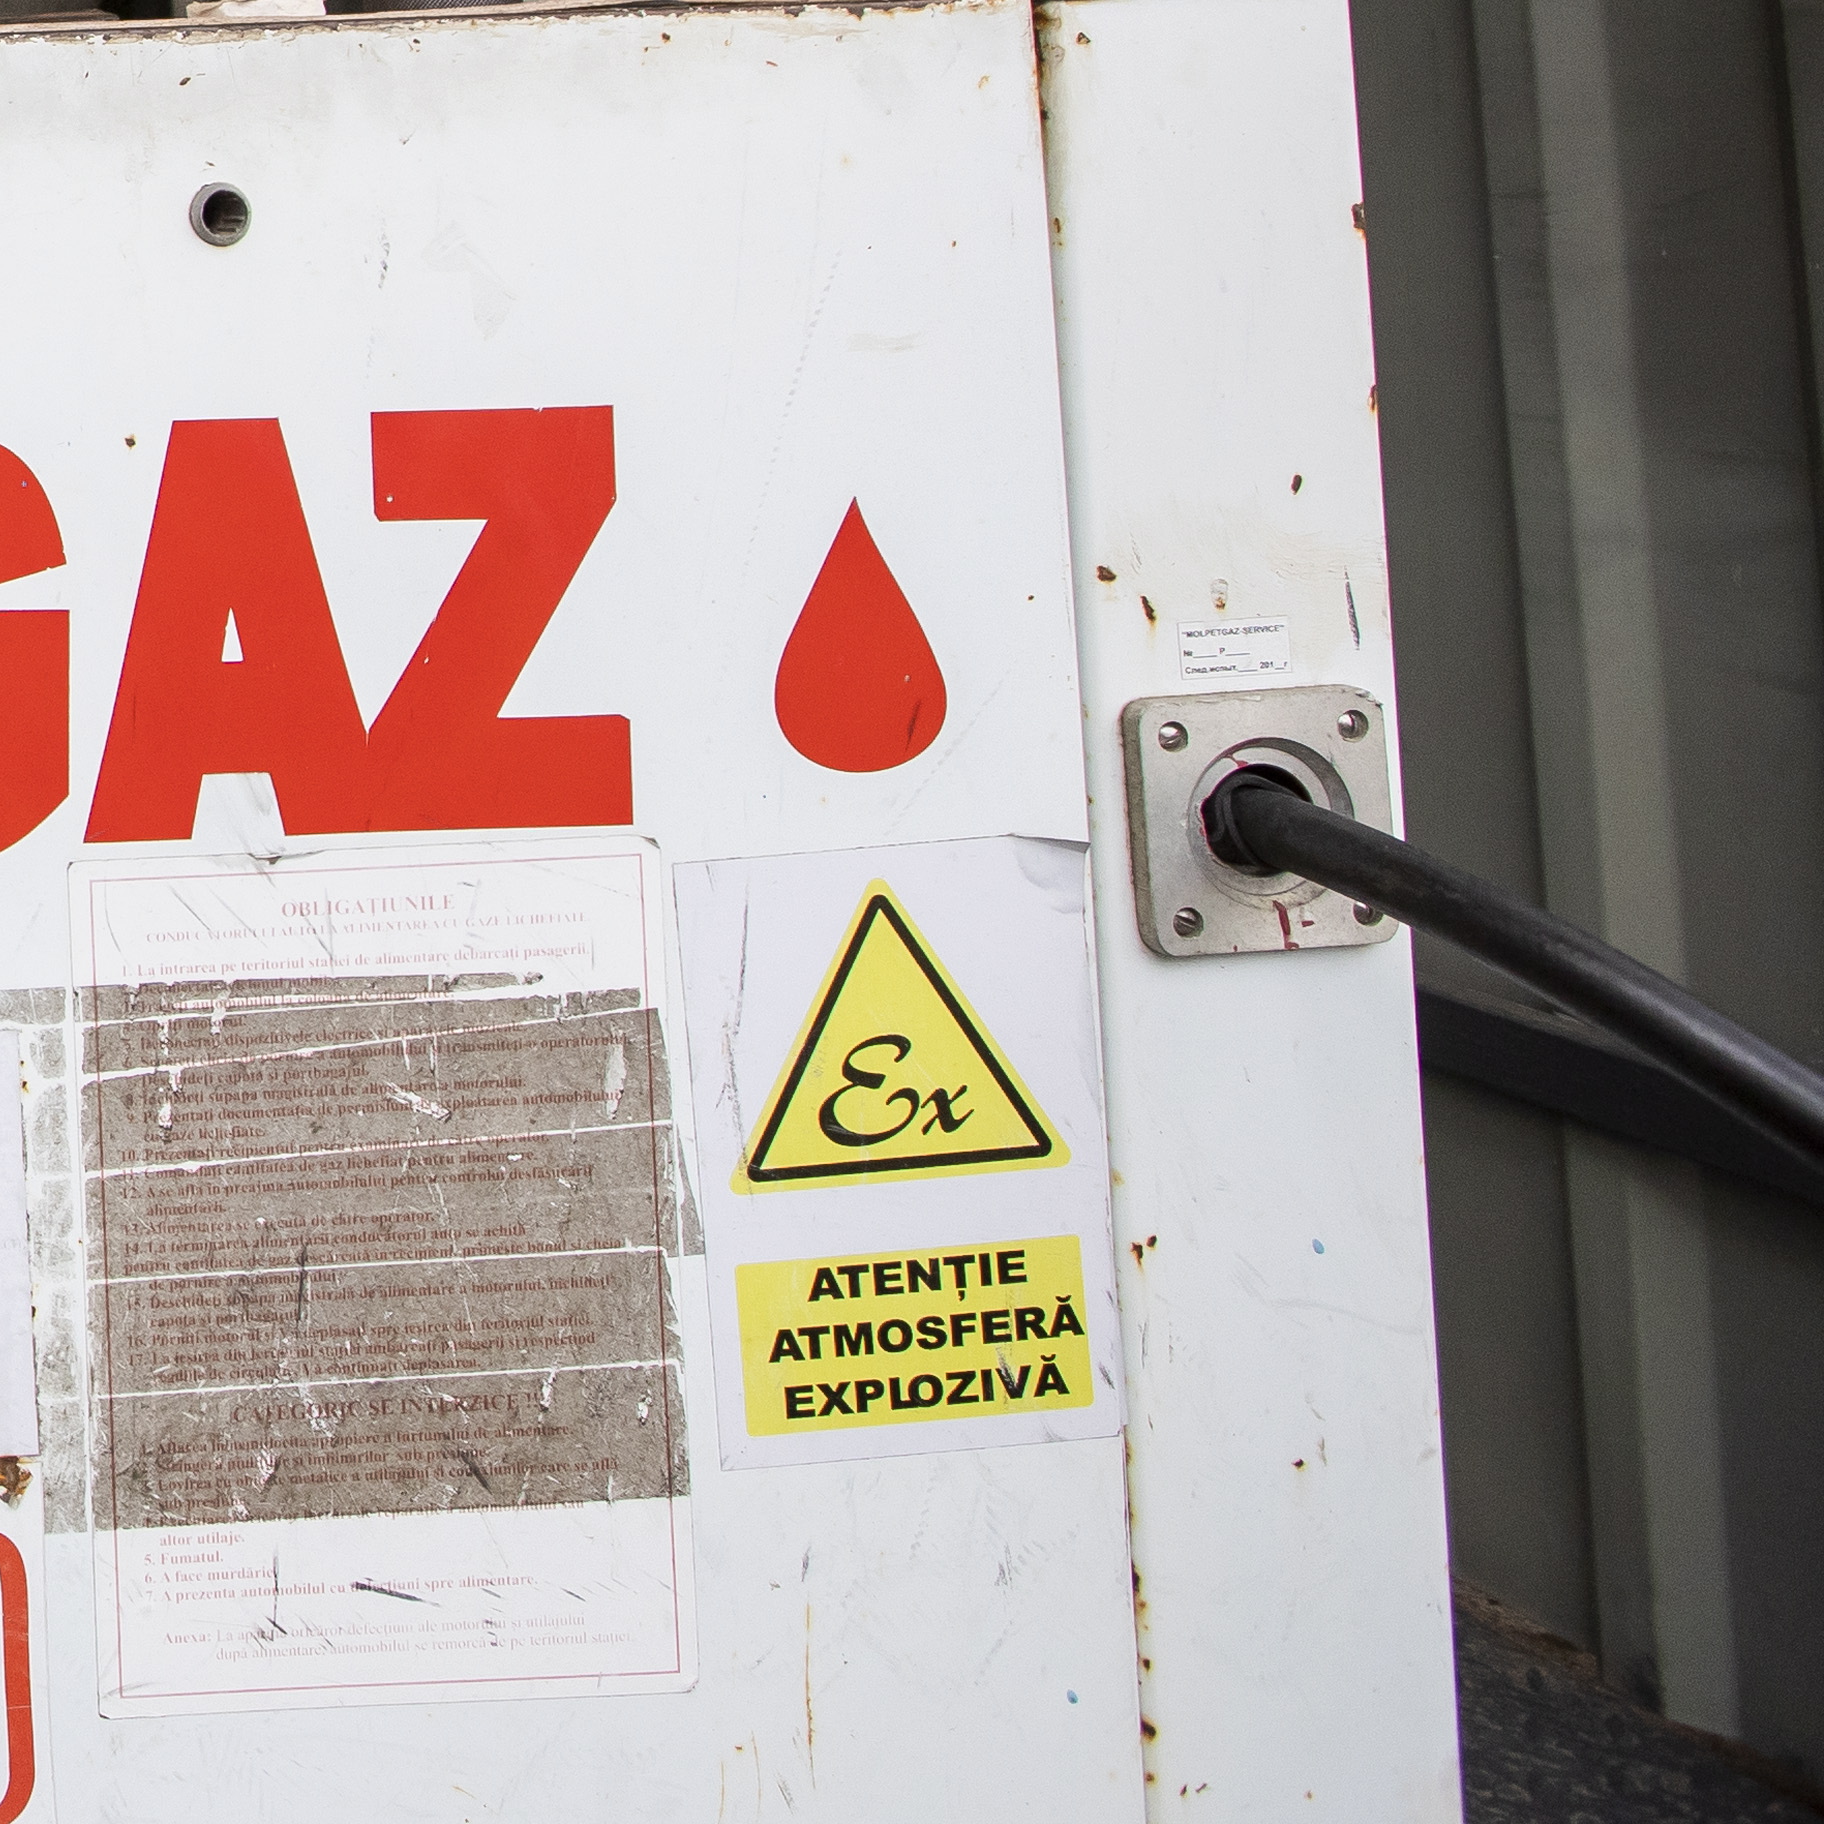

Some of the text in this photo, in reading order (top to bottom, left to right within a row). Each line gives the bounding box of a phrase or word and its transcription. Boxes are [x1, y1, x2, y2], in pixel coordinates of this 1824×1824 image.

[280, 893, 454, 921] OBLIGAȚIUNILE
[819, 1034, 975, 1147] Ex
[808, 1249, 1028, 1302] ATENȚIE
[768, 1295, 1085, 1364] ATMOSFERĂ
[785, 1355, 1070, 1420] EXPLOZIVĂ
[143, 1549, 223, 1566] 5. Fumatul.
